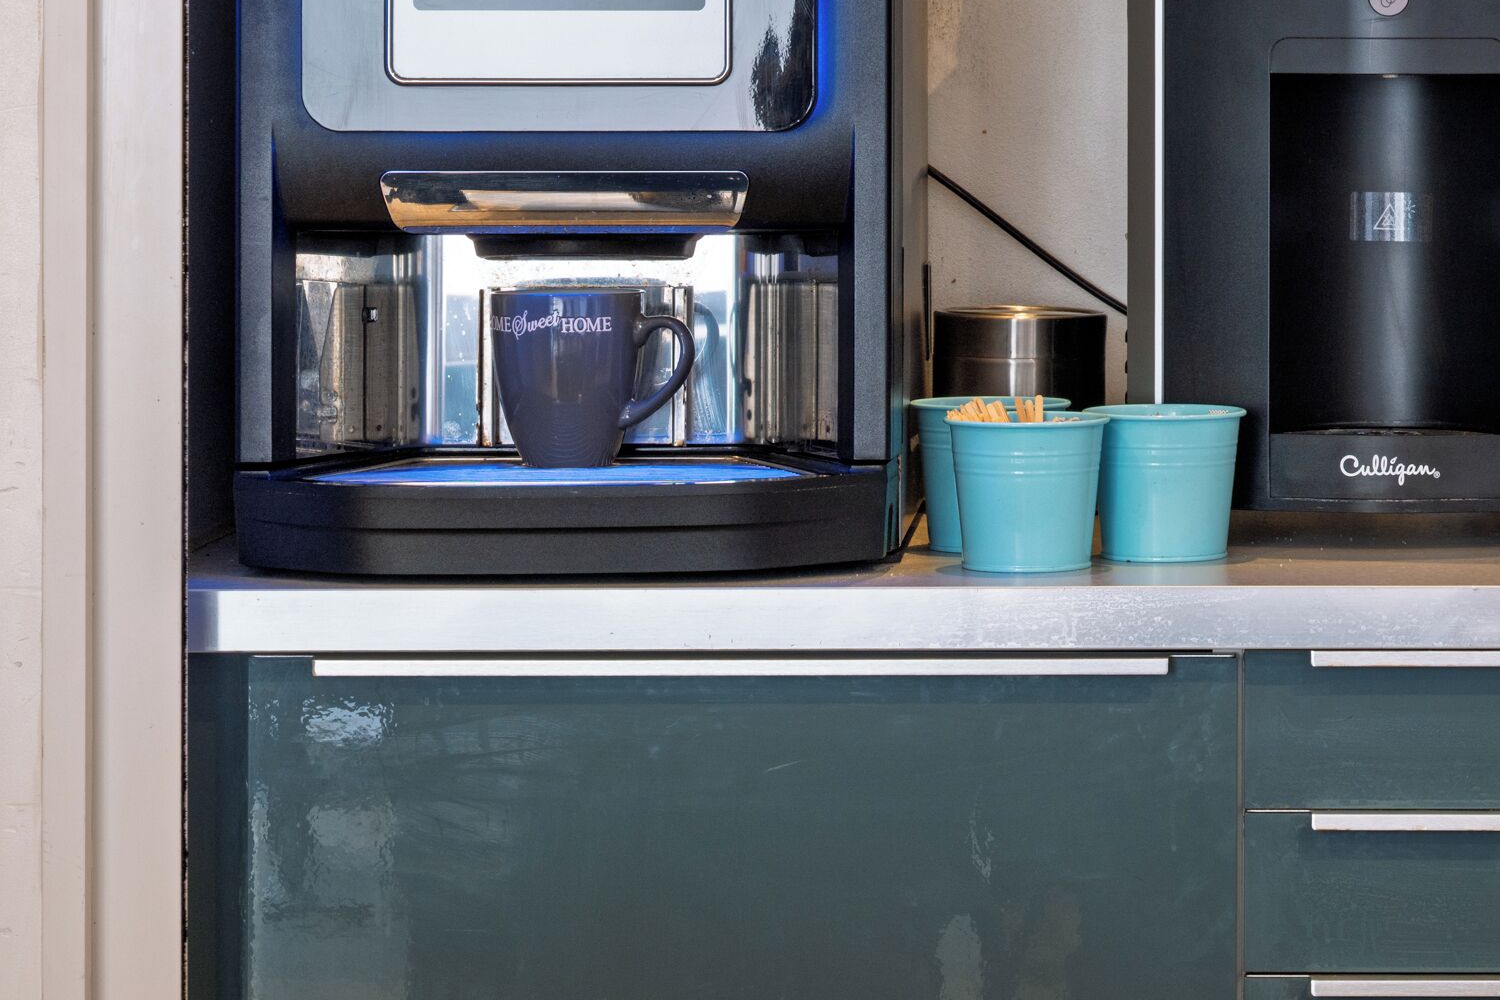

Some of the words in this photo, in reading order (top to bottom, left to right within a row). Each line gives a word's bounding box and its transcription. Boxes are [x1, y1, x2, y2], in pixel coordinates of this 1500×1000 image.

[490, 315, 511, 332] OME
[512, 309, 560, 340] Sweet
[561, 316, 612, 333] HOME
